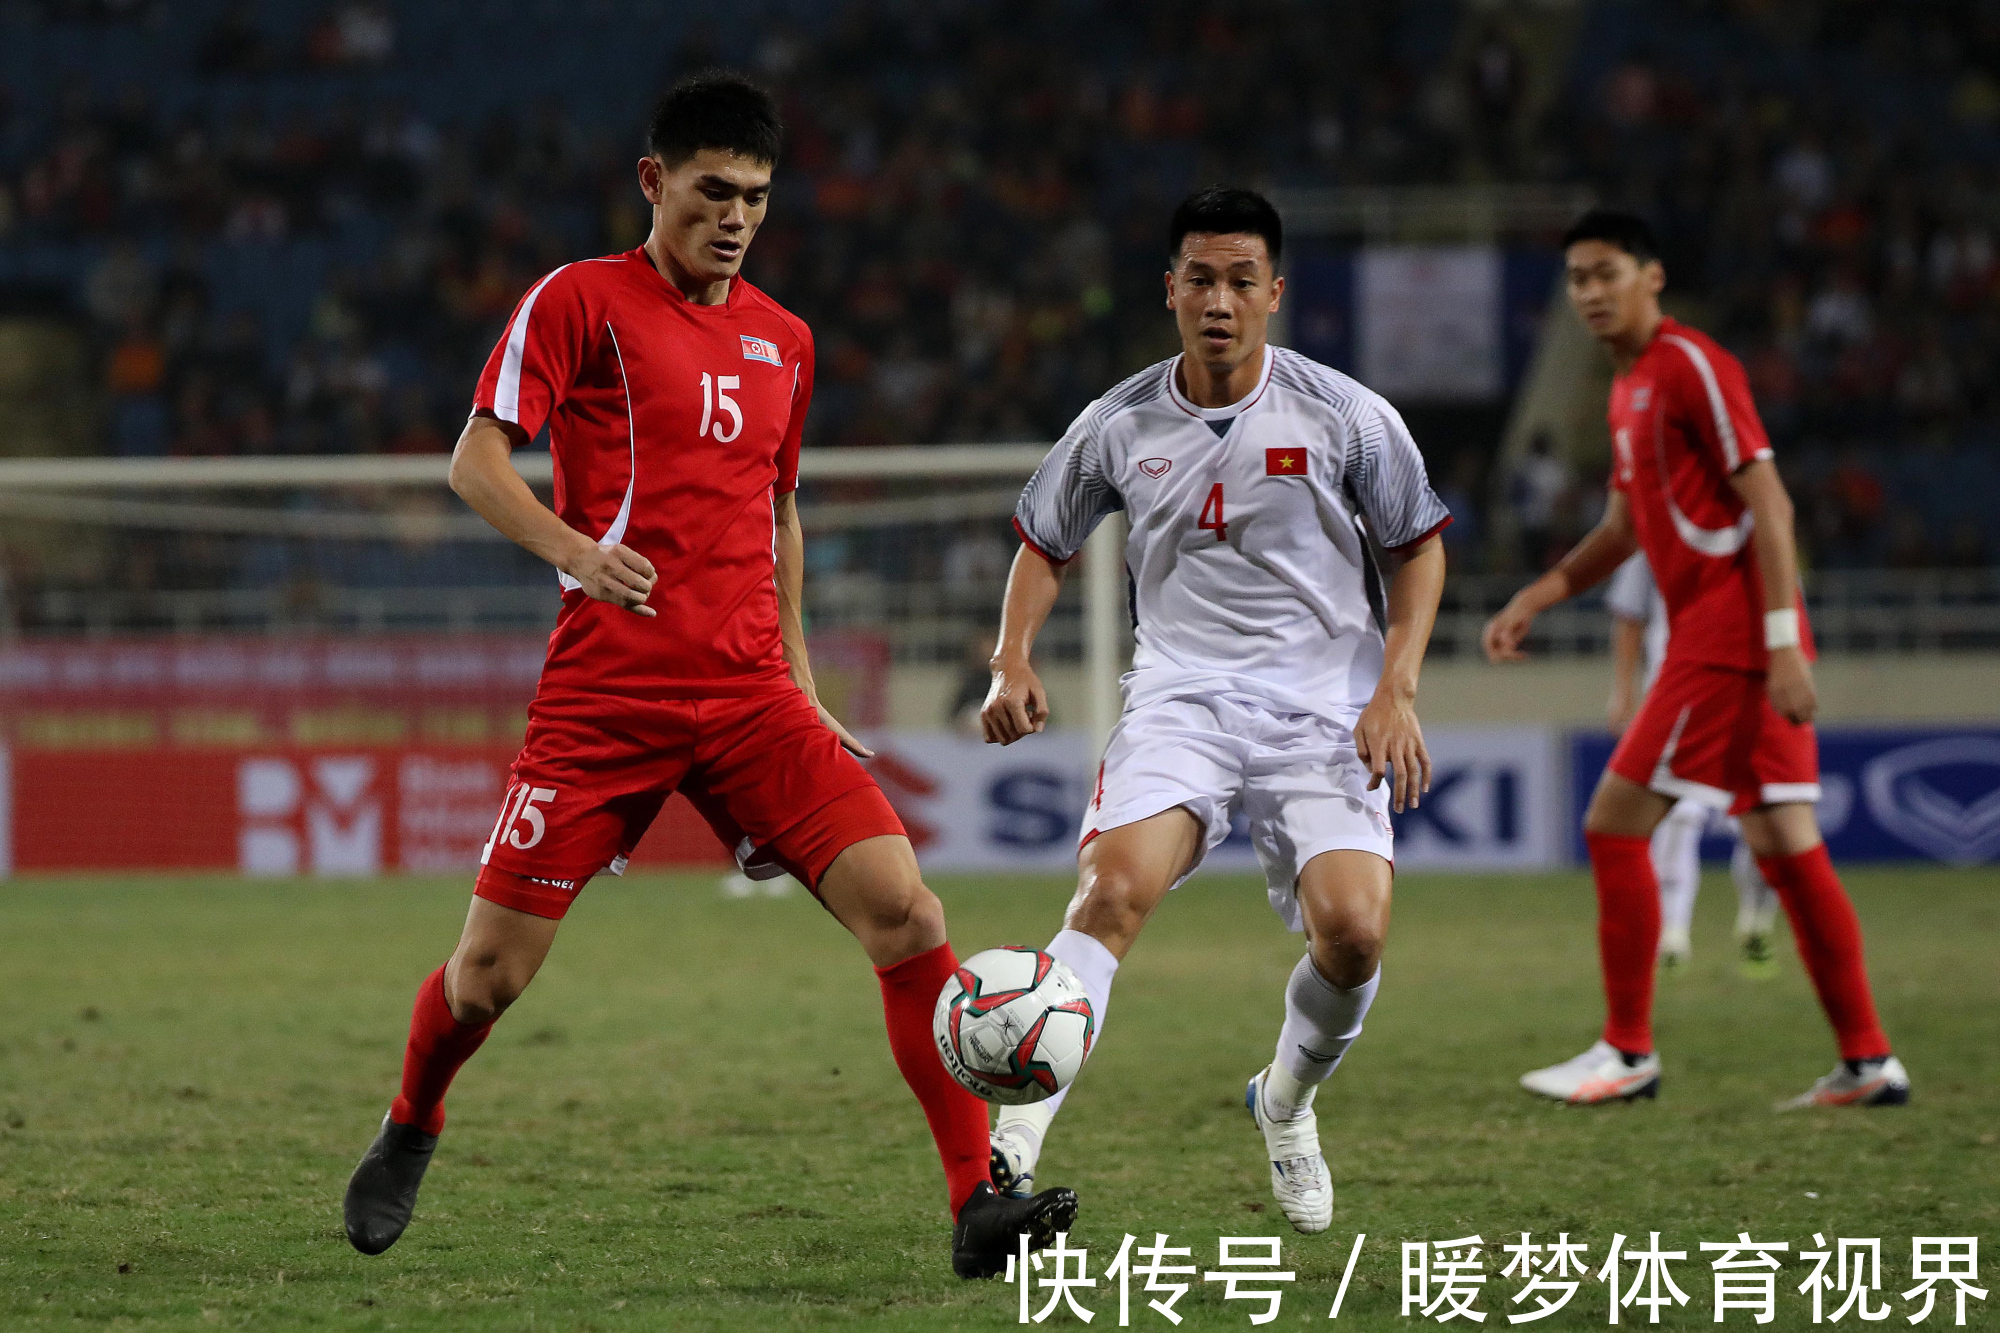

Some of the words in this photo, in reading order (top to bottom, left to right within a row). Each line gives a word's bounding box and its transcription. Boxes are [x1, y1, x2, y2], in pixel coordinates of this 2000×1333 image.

[699, 371, 743, 443] 15
[1198, 483, 1228, 541] 4
[500, 782, 557, 850] 15
[939, 1034, 994, 1097] molten
